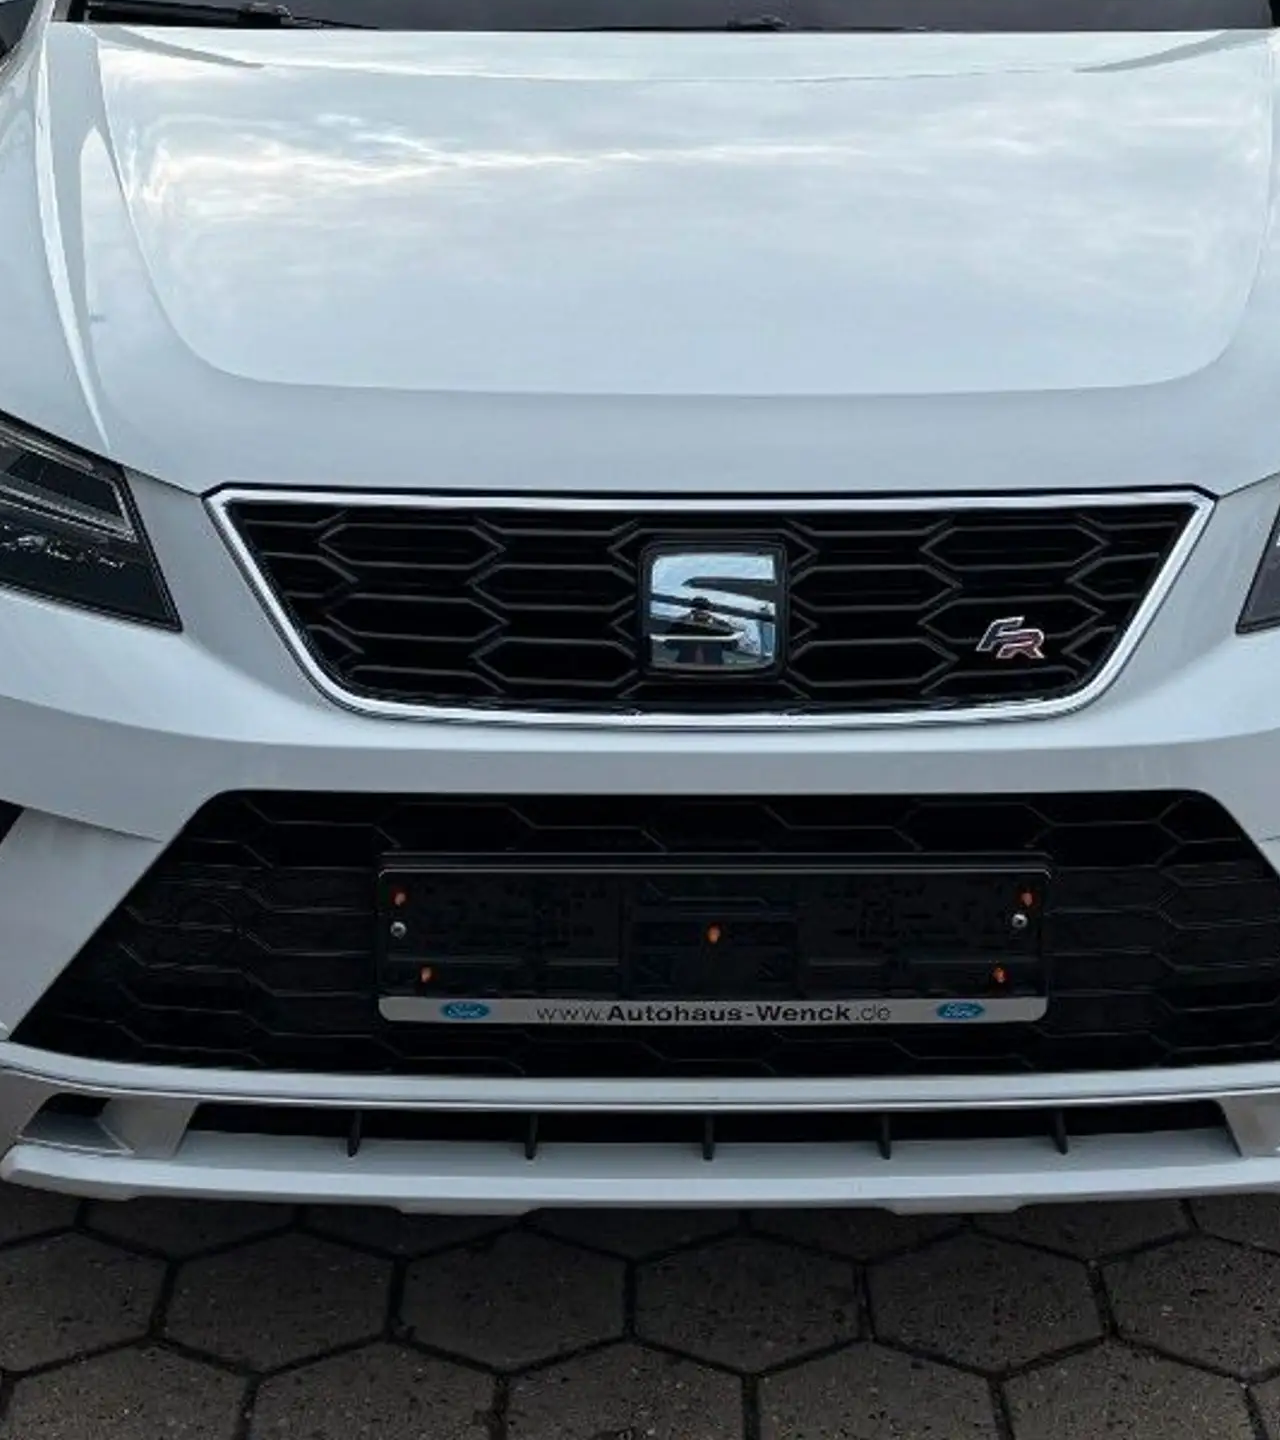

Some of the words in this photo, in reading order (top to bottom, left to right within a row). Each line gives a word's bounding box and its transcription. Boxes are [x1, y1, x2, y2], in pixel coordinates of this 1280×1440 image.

[976, 616, 1046, 660] FR
[442, 1002, 489, 1019] Ford
[535, 1001, 892, 1024] www.Autohaus-Wenck.de
[938, 1002, 983, 1019] Ford
